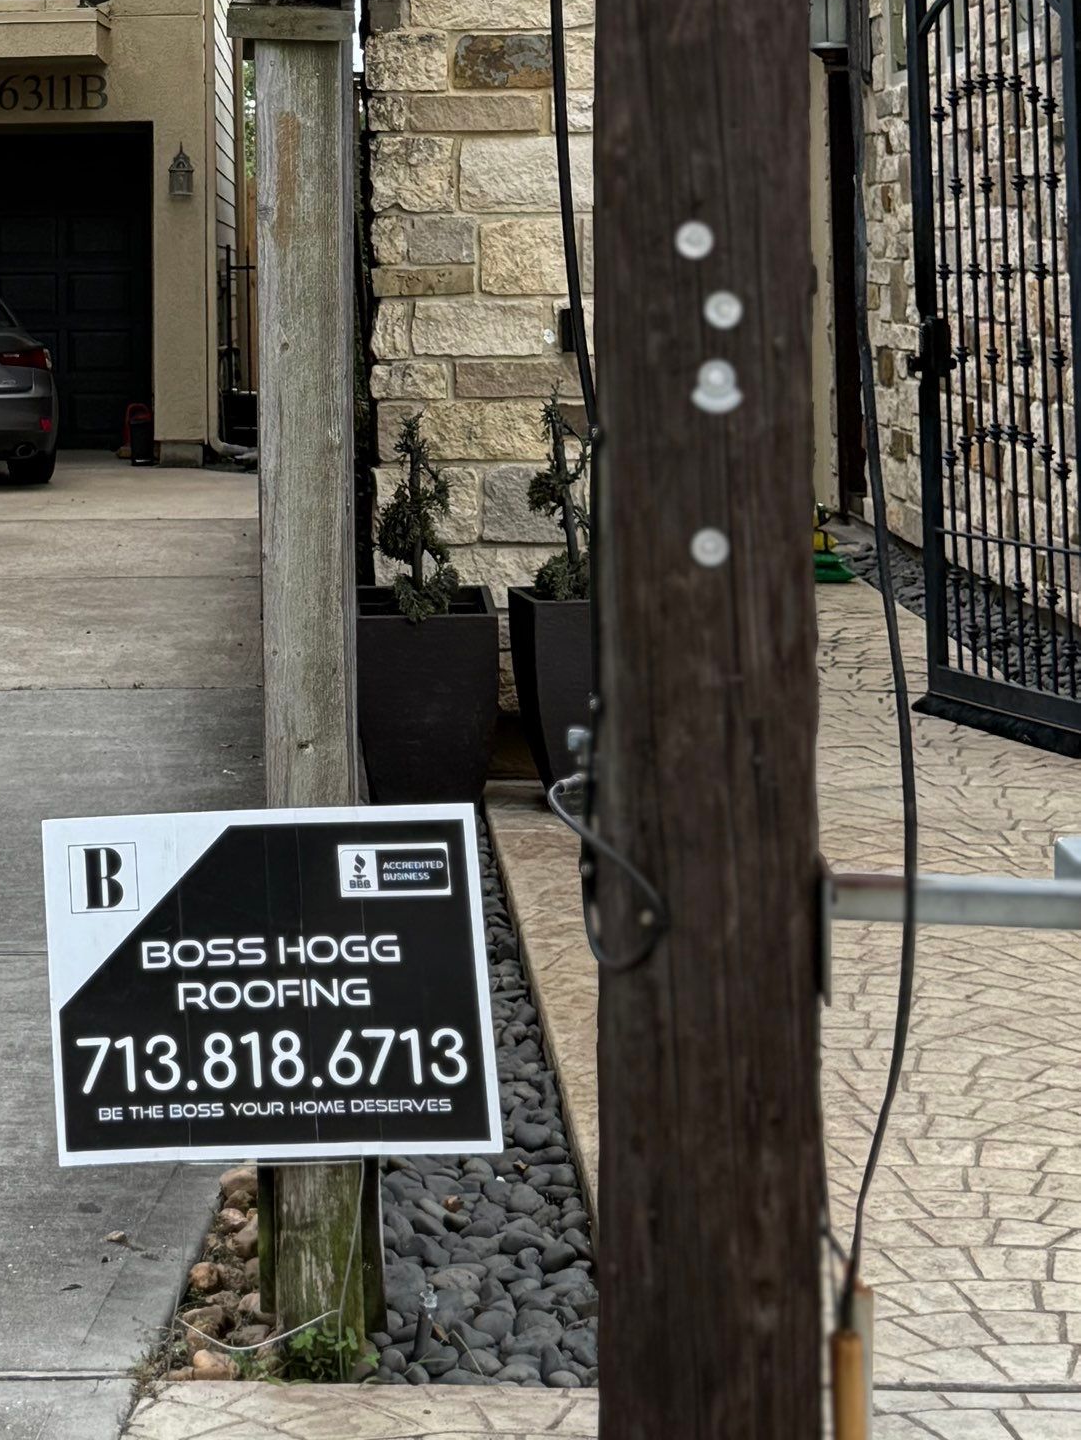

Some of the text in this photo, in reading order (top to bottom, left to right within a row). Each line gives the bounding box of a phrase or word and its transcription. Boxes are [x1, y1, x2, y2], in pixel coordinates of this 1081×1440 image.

[83, 847, 124, 909] B
[382, 860, 445, 870] ACCREDITED
[382, 871, 431, 881] BUSINESS
[348, 879, 372, 889] BBB
[141, 934, 401, 970] BOSS HOGG
[177, 977, 371, 1011] ROOFING
[75, 1027, 468, 1095] 713.818.6713
[98, 1098, 453, 1122] BE THE BOSS YOUR HOME DESERVES
